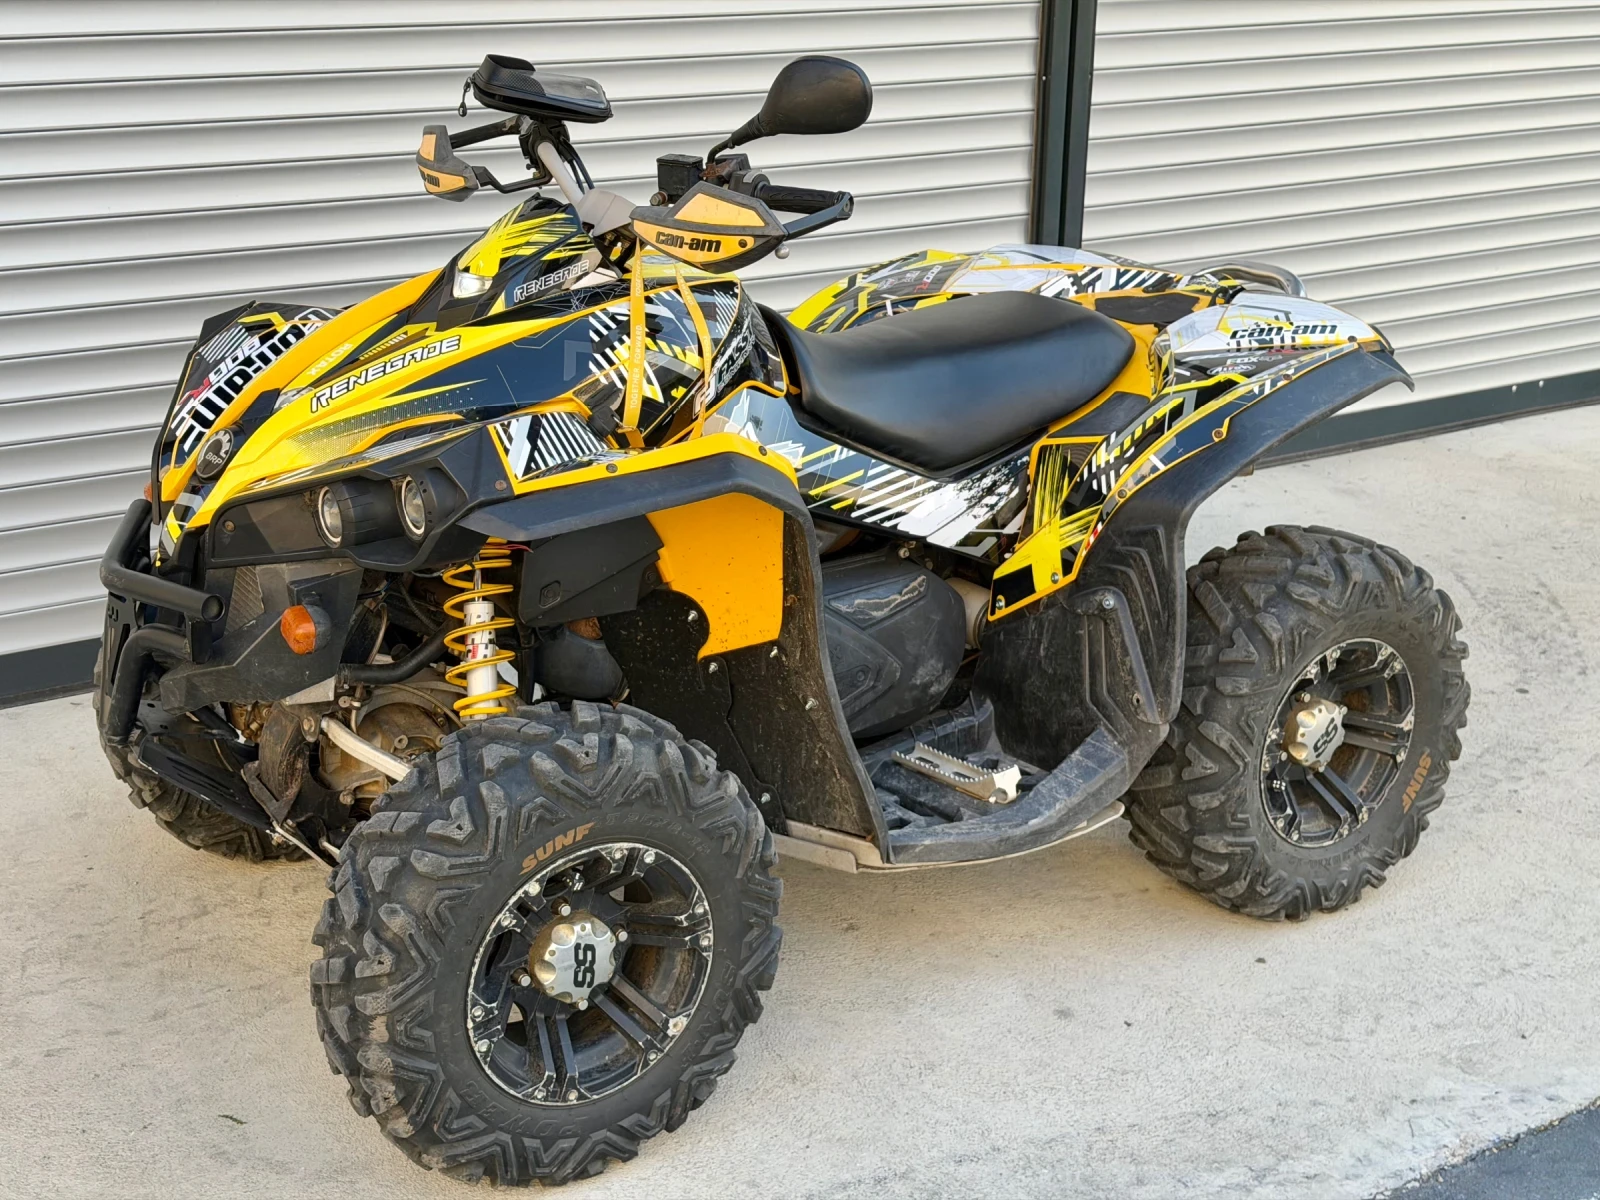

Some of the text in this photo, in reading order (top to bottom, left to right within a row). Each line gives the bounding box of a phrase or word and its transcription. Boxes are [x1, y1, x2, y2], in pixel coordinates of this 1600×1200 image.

[655, 230, 722, 253] can-am
[513, 259, 590, 303] RENEGADE
[1229, 322, 1339, 341] can-am
[310, 334, 461, 413] RENEGADE
[205, 451, 223, 466] BRP
[1312, 717, 1338, 759] SS
[573, 942, 596, 988] SS
